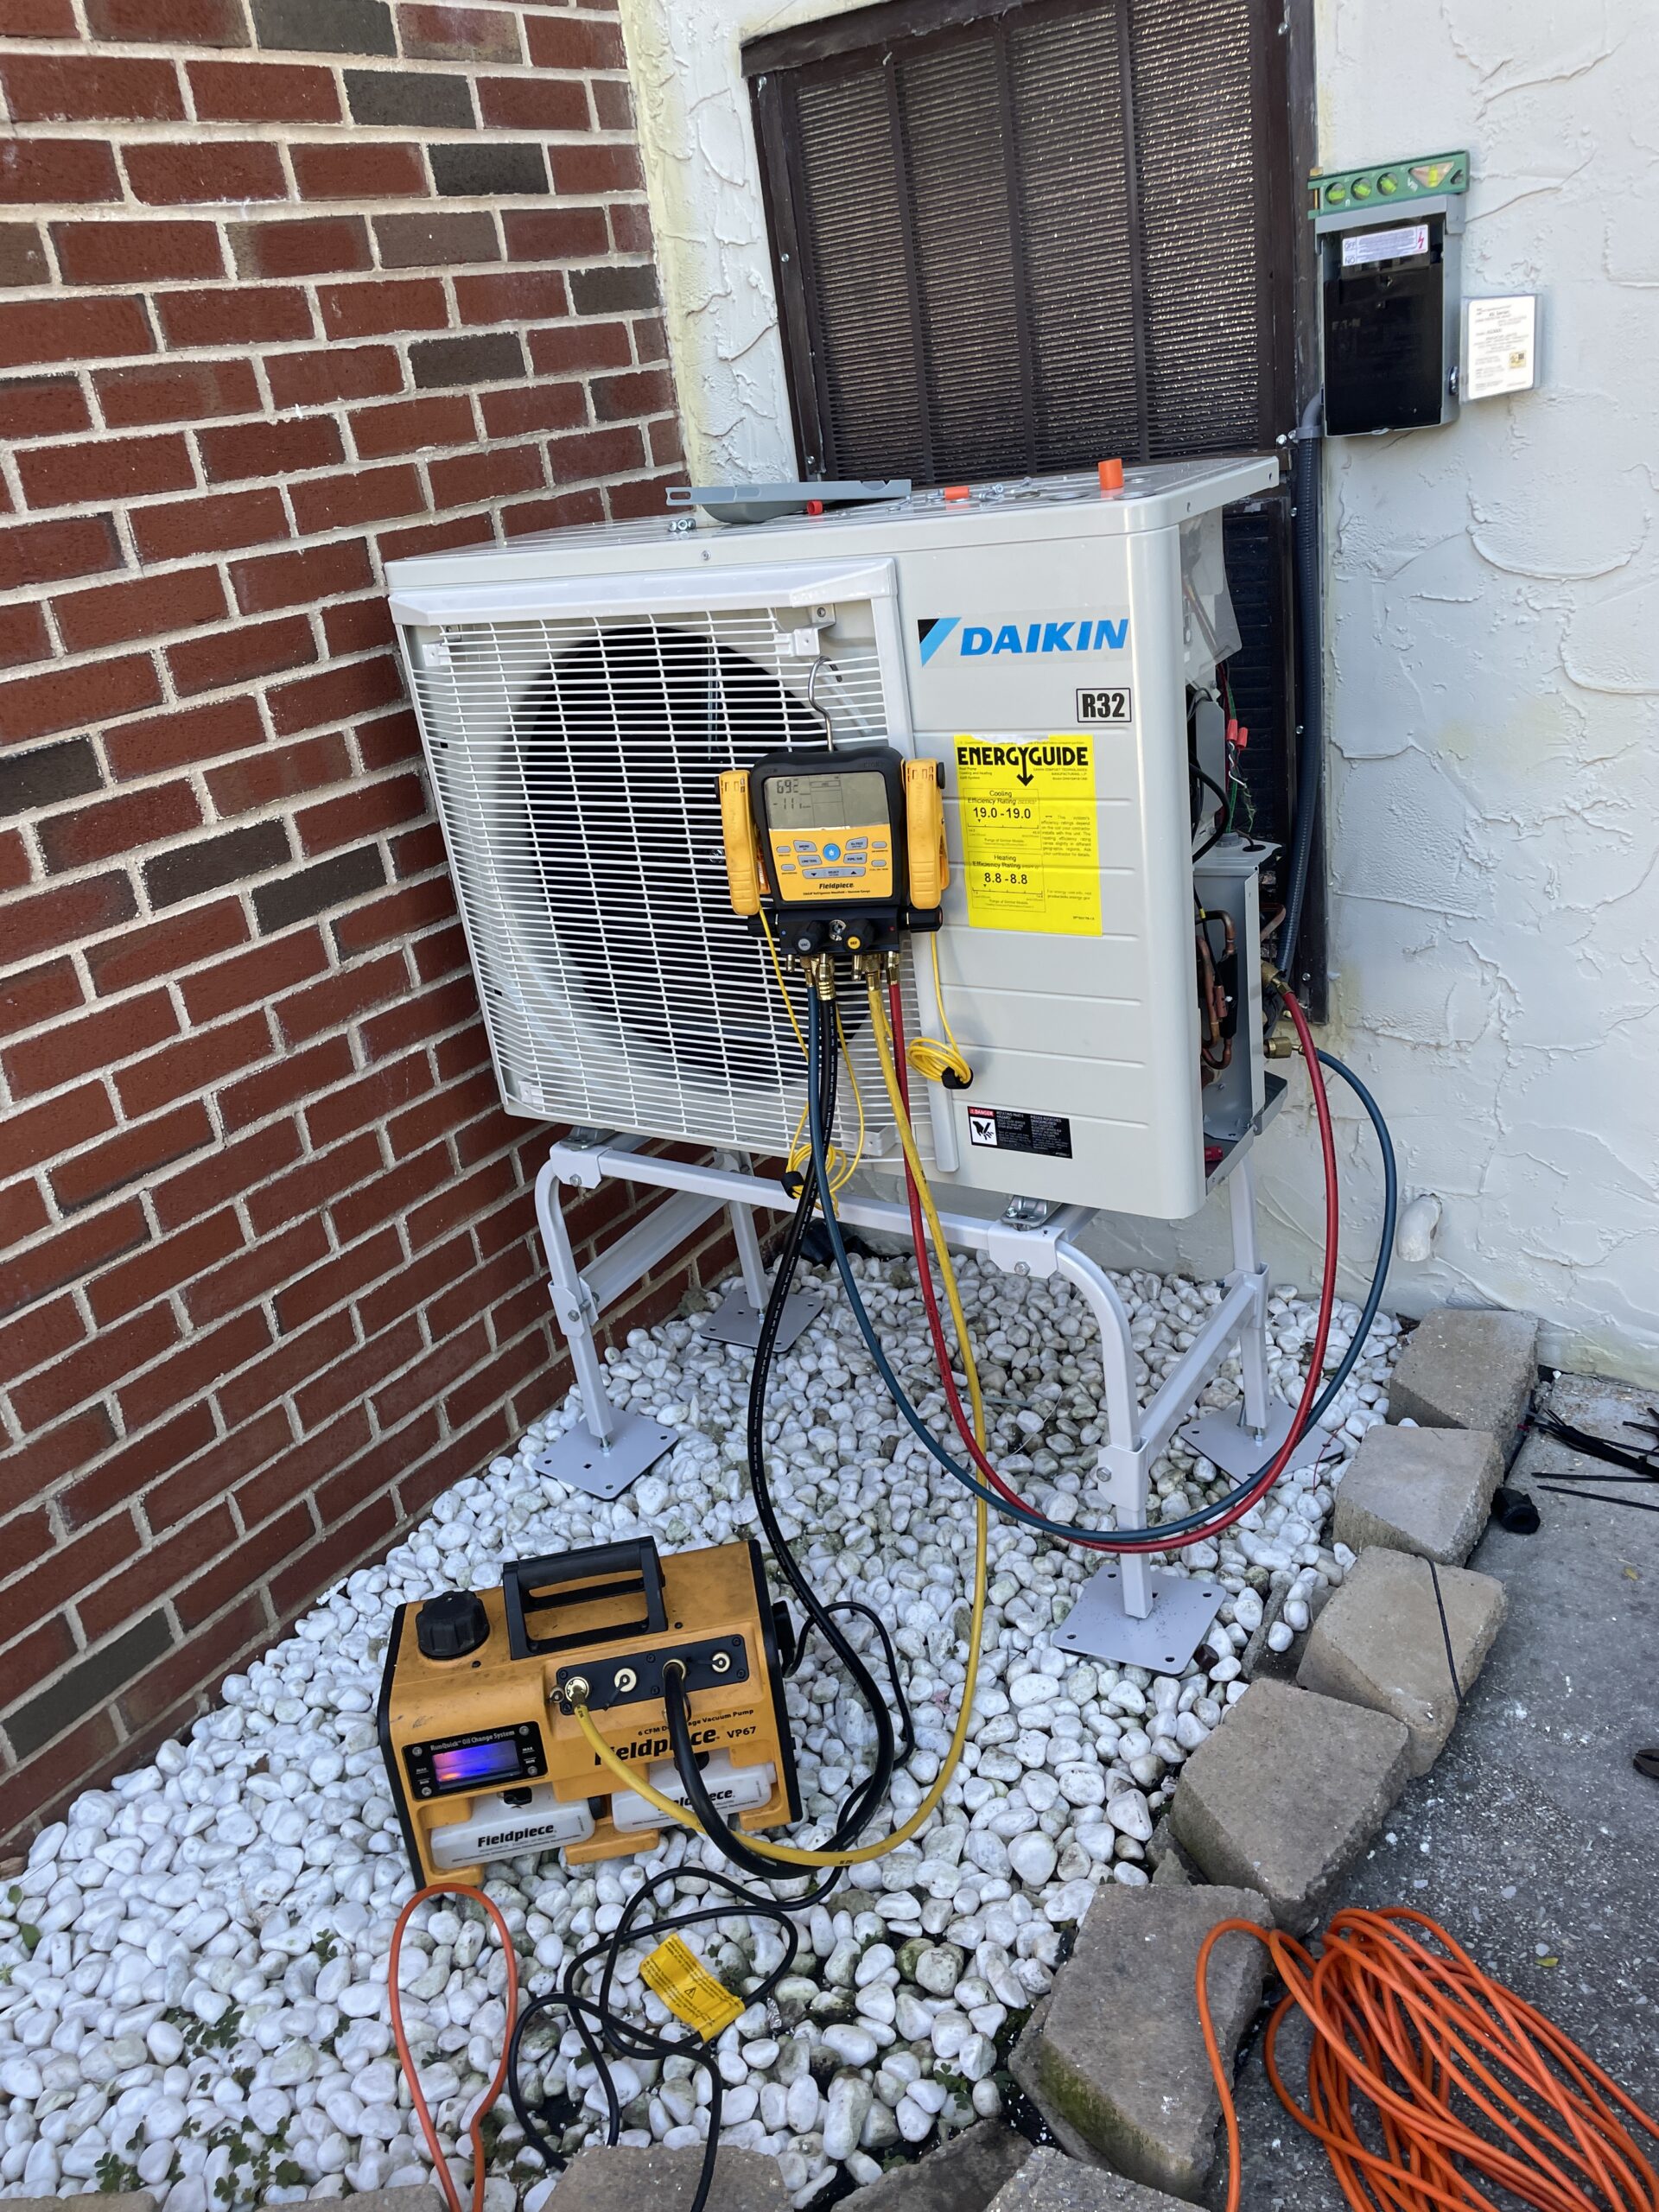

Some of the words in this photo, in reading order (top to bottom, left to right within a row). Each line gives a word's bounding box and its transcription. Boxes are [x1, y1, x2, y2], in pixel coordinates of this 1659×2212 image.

[960, 619, 1128, 656] DAIKIN
[1082, 693, 1125, 718] R32
[957, 747, 1088, 766] ENERGYGUIDE
[973, 807, 997, 817] 19.0
[1006, 808, 1031, 818] 19.0
[984, 873, 1001, 883] 8.8
[1010, 874, 1028, 884] 8.8
[702, 1713, 731, 1724] Vacuum
[733, 1708, 754, 1718] Pump
[471, 1734, 493, 1743] Change
[493, 1731, 515, 1739] System
[644, 1727, 660, 1736] CFM
[727, 1726, 757, 1739] VP67
[478, 1824, 555, 1847] Fieldpiece
